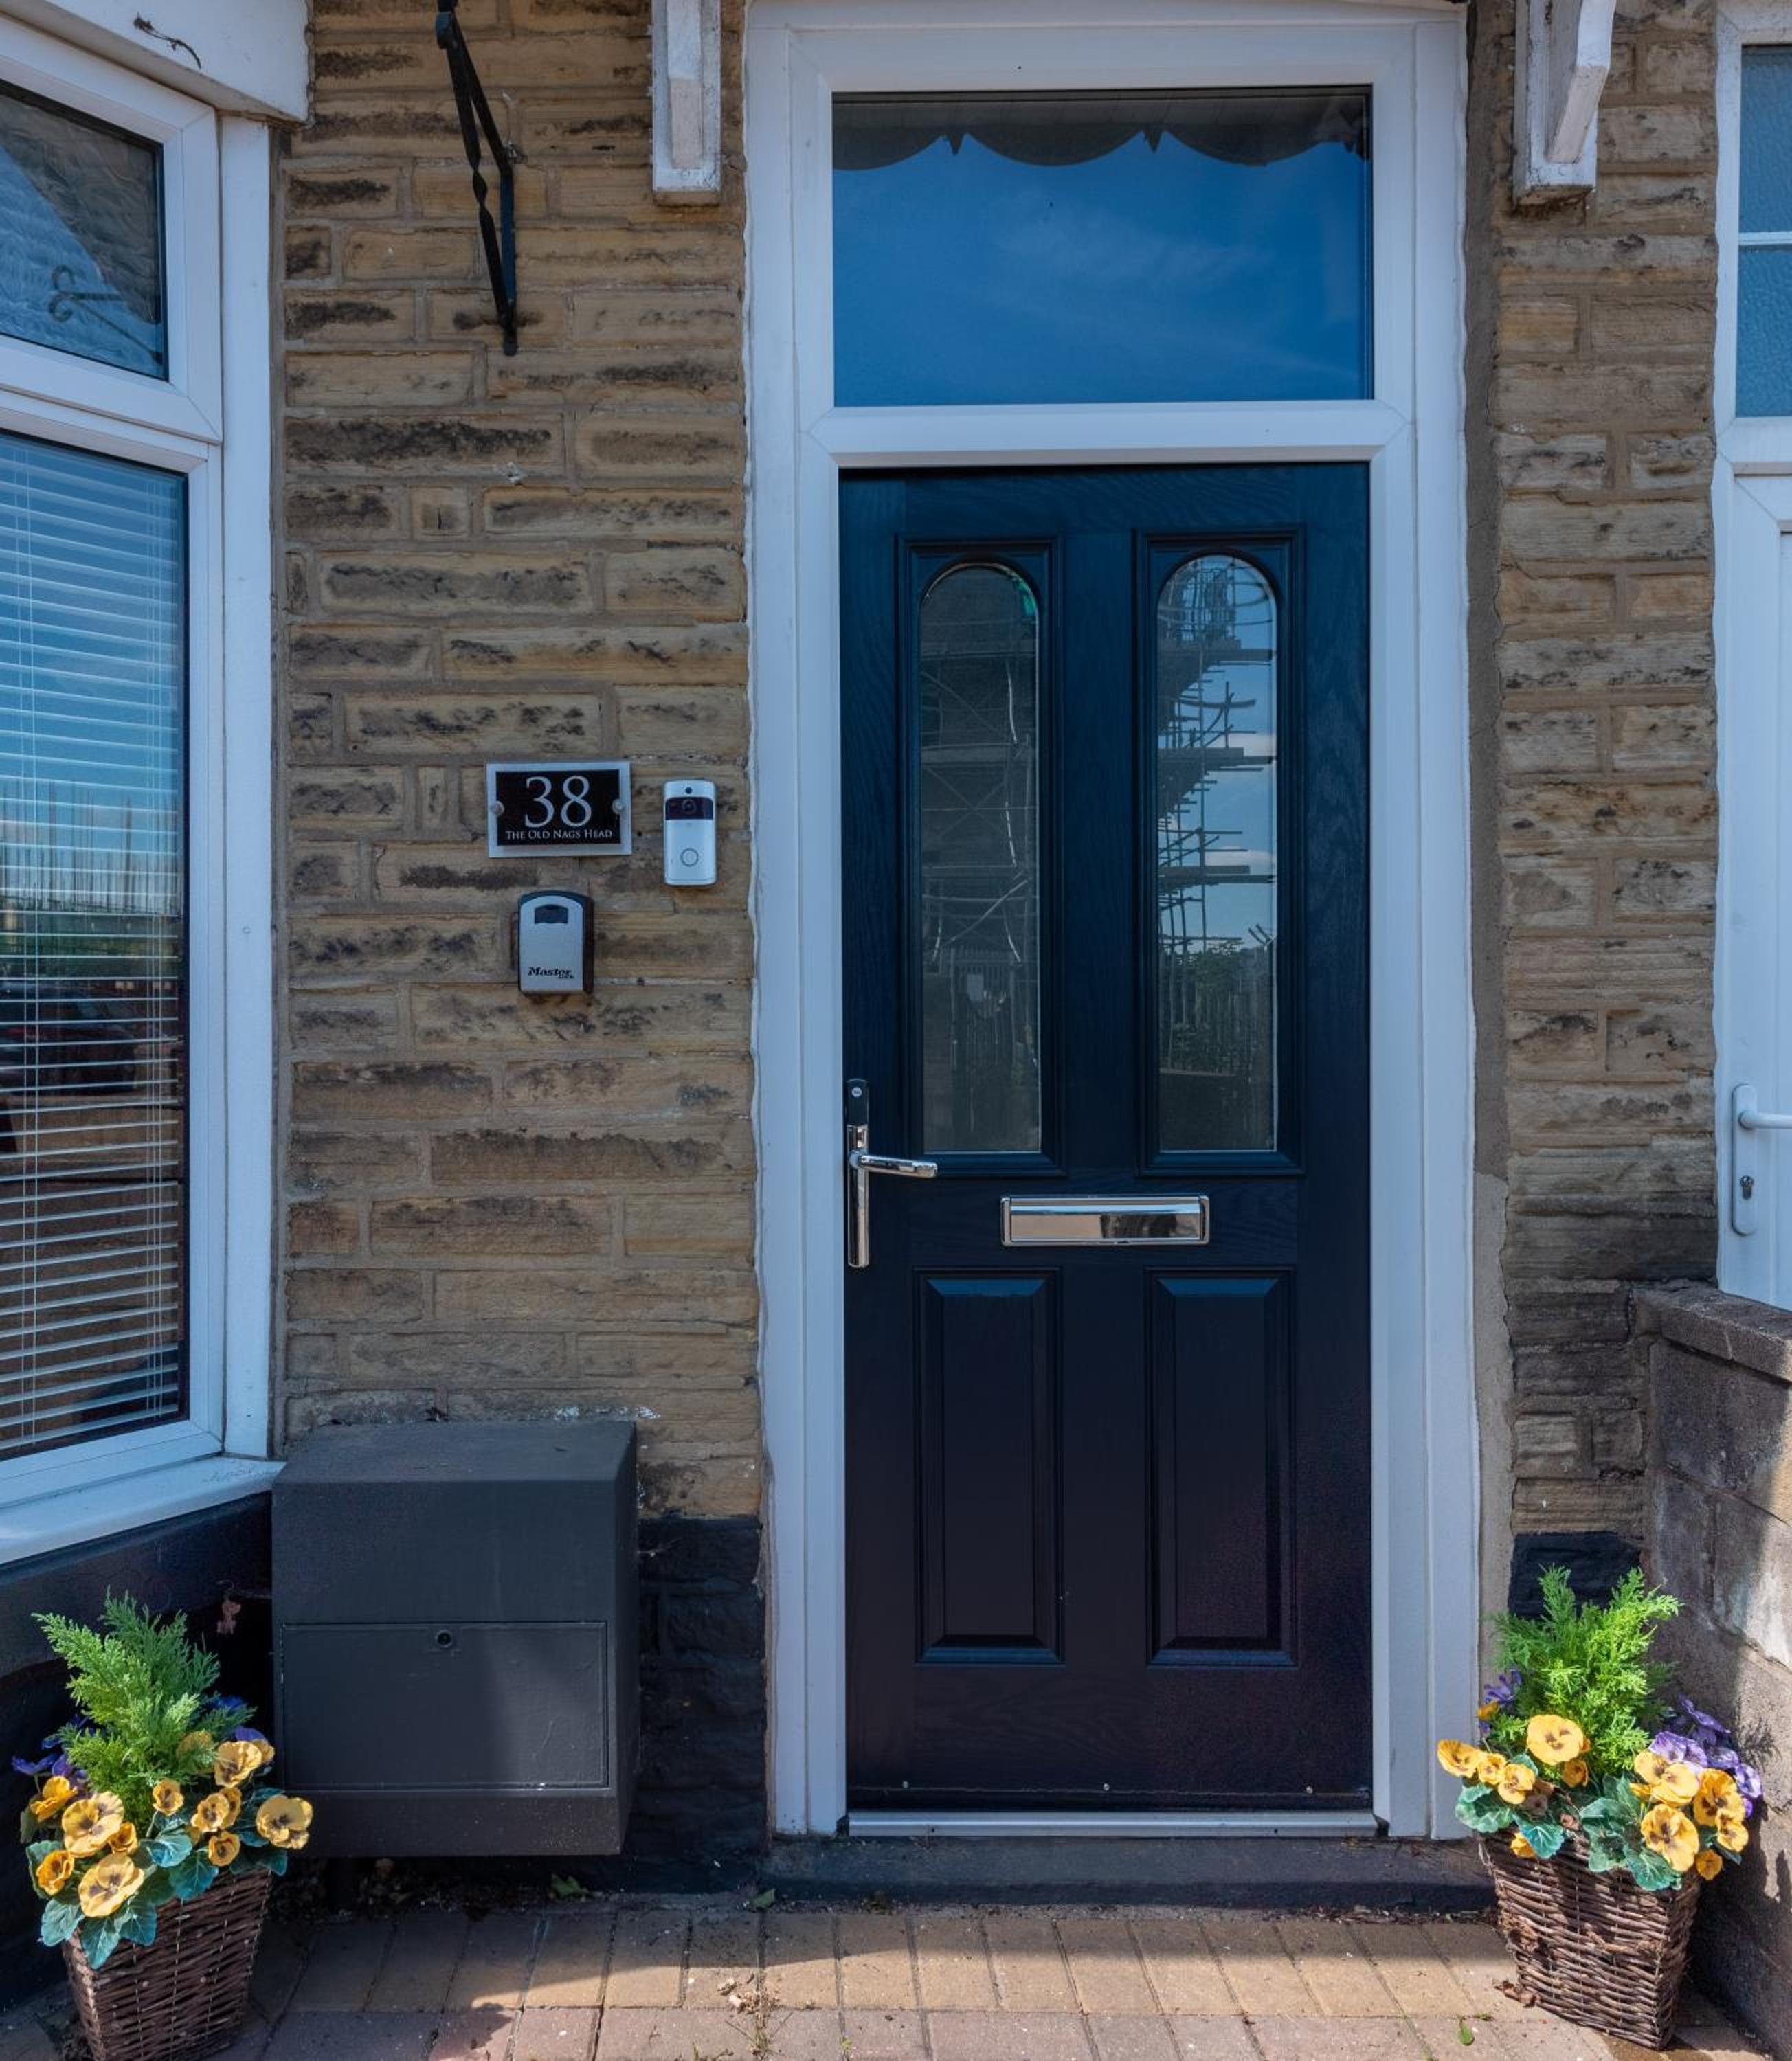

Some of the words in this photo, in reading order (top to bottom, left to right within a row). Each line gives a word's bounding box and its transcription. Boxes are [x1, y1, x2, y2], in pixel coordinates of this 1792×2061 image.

[524, 776, 592, 828] 38
[506, 831, 526, 840] THE
[528, 830, 550, 839] OLD
[553, 829, 581, 839] NAGS
[584, 829, 613, 838] HEAD
[528, 967, 572, 976] Master
